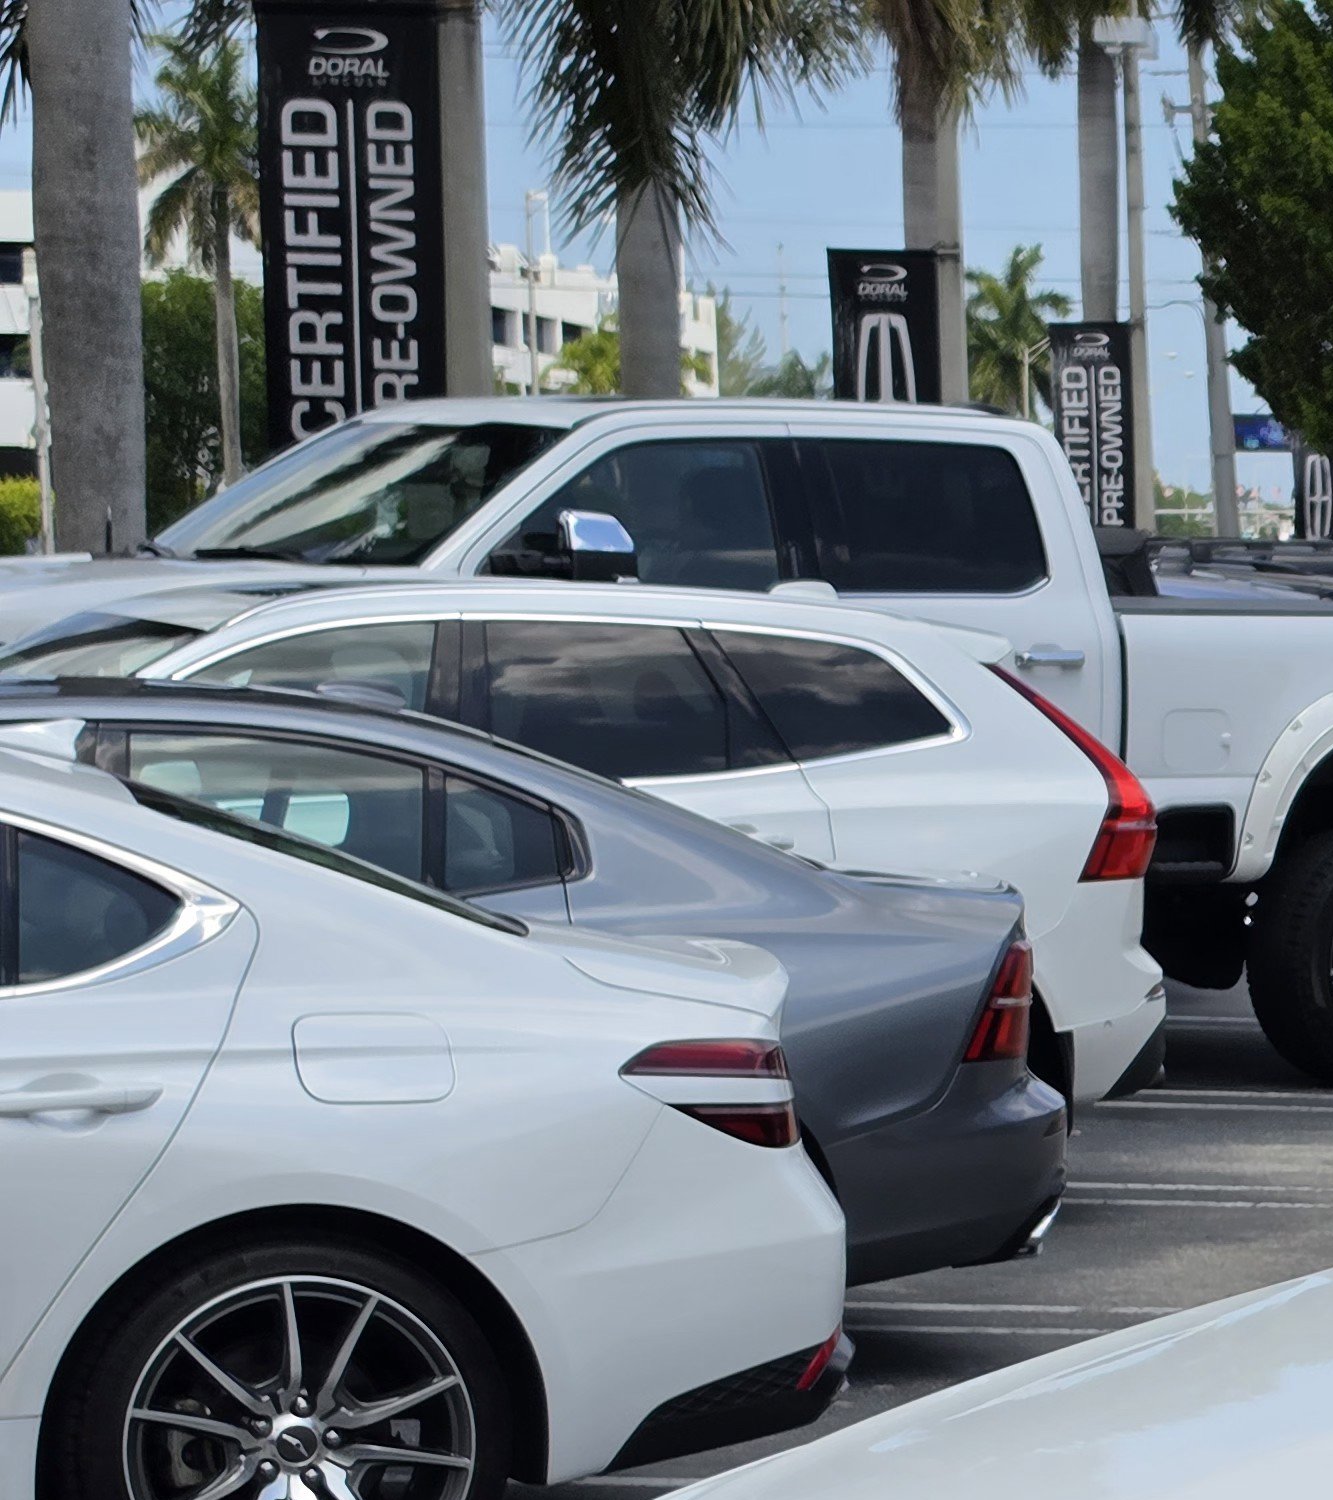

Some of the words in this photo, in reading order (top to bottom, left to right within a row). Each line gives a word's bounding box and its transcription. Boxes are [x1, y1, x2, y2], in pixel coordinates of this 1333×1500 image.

[308, 56, 390, 78] DORAL
[280, 98, 346, 442] CERTIFIED
[366, 100, 420, 410] RE-OWNED
[858, 282, 909, 297] DORAL
[1099, 365, 1125, 527] PRE-OWNED
